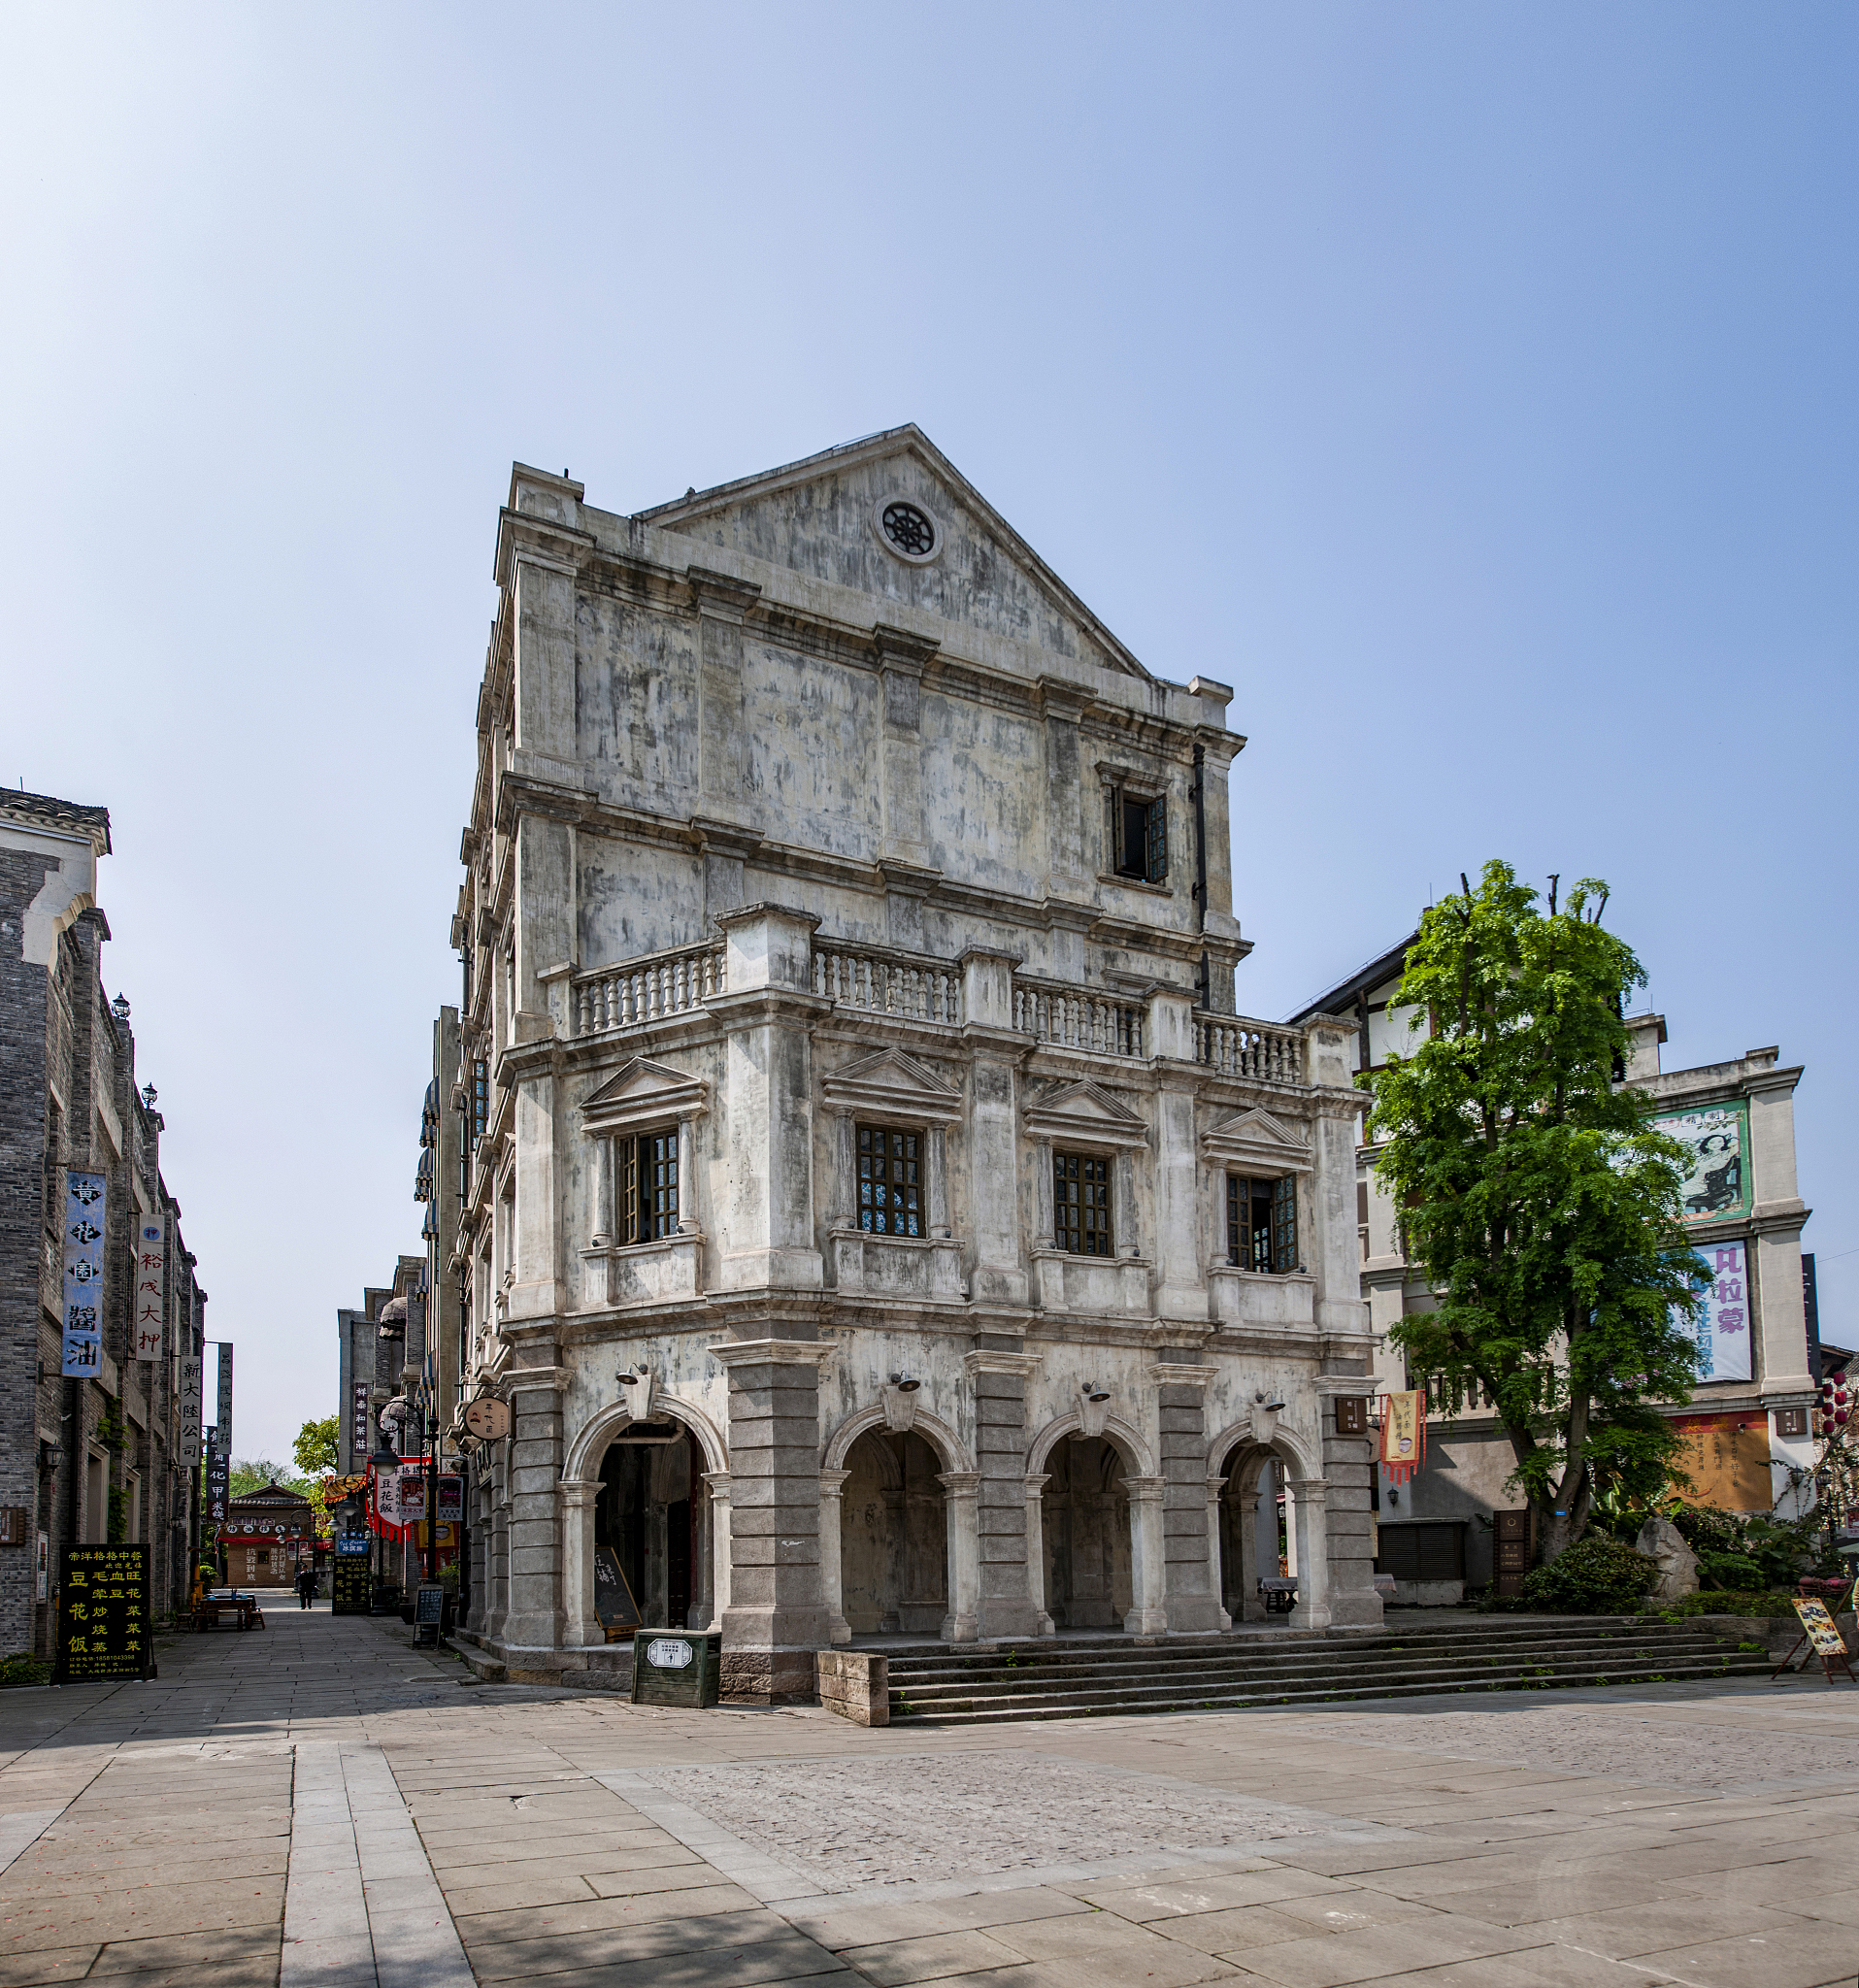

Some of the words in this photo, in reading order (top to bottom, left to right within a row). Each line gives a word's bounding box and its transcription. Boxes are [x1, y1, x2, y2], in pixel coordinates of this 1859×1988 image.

[1716, 1247, 1744, 1334] 凡拉蒙
[182, 1362, 200, 1458] 新大陸公司
[379, 1478, 394, 1513] 豆花飯
[68, 1572, 88, 1653] 豆花饭
[92, 1571, 142, 1581] 毛血旺
